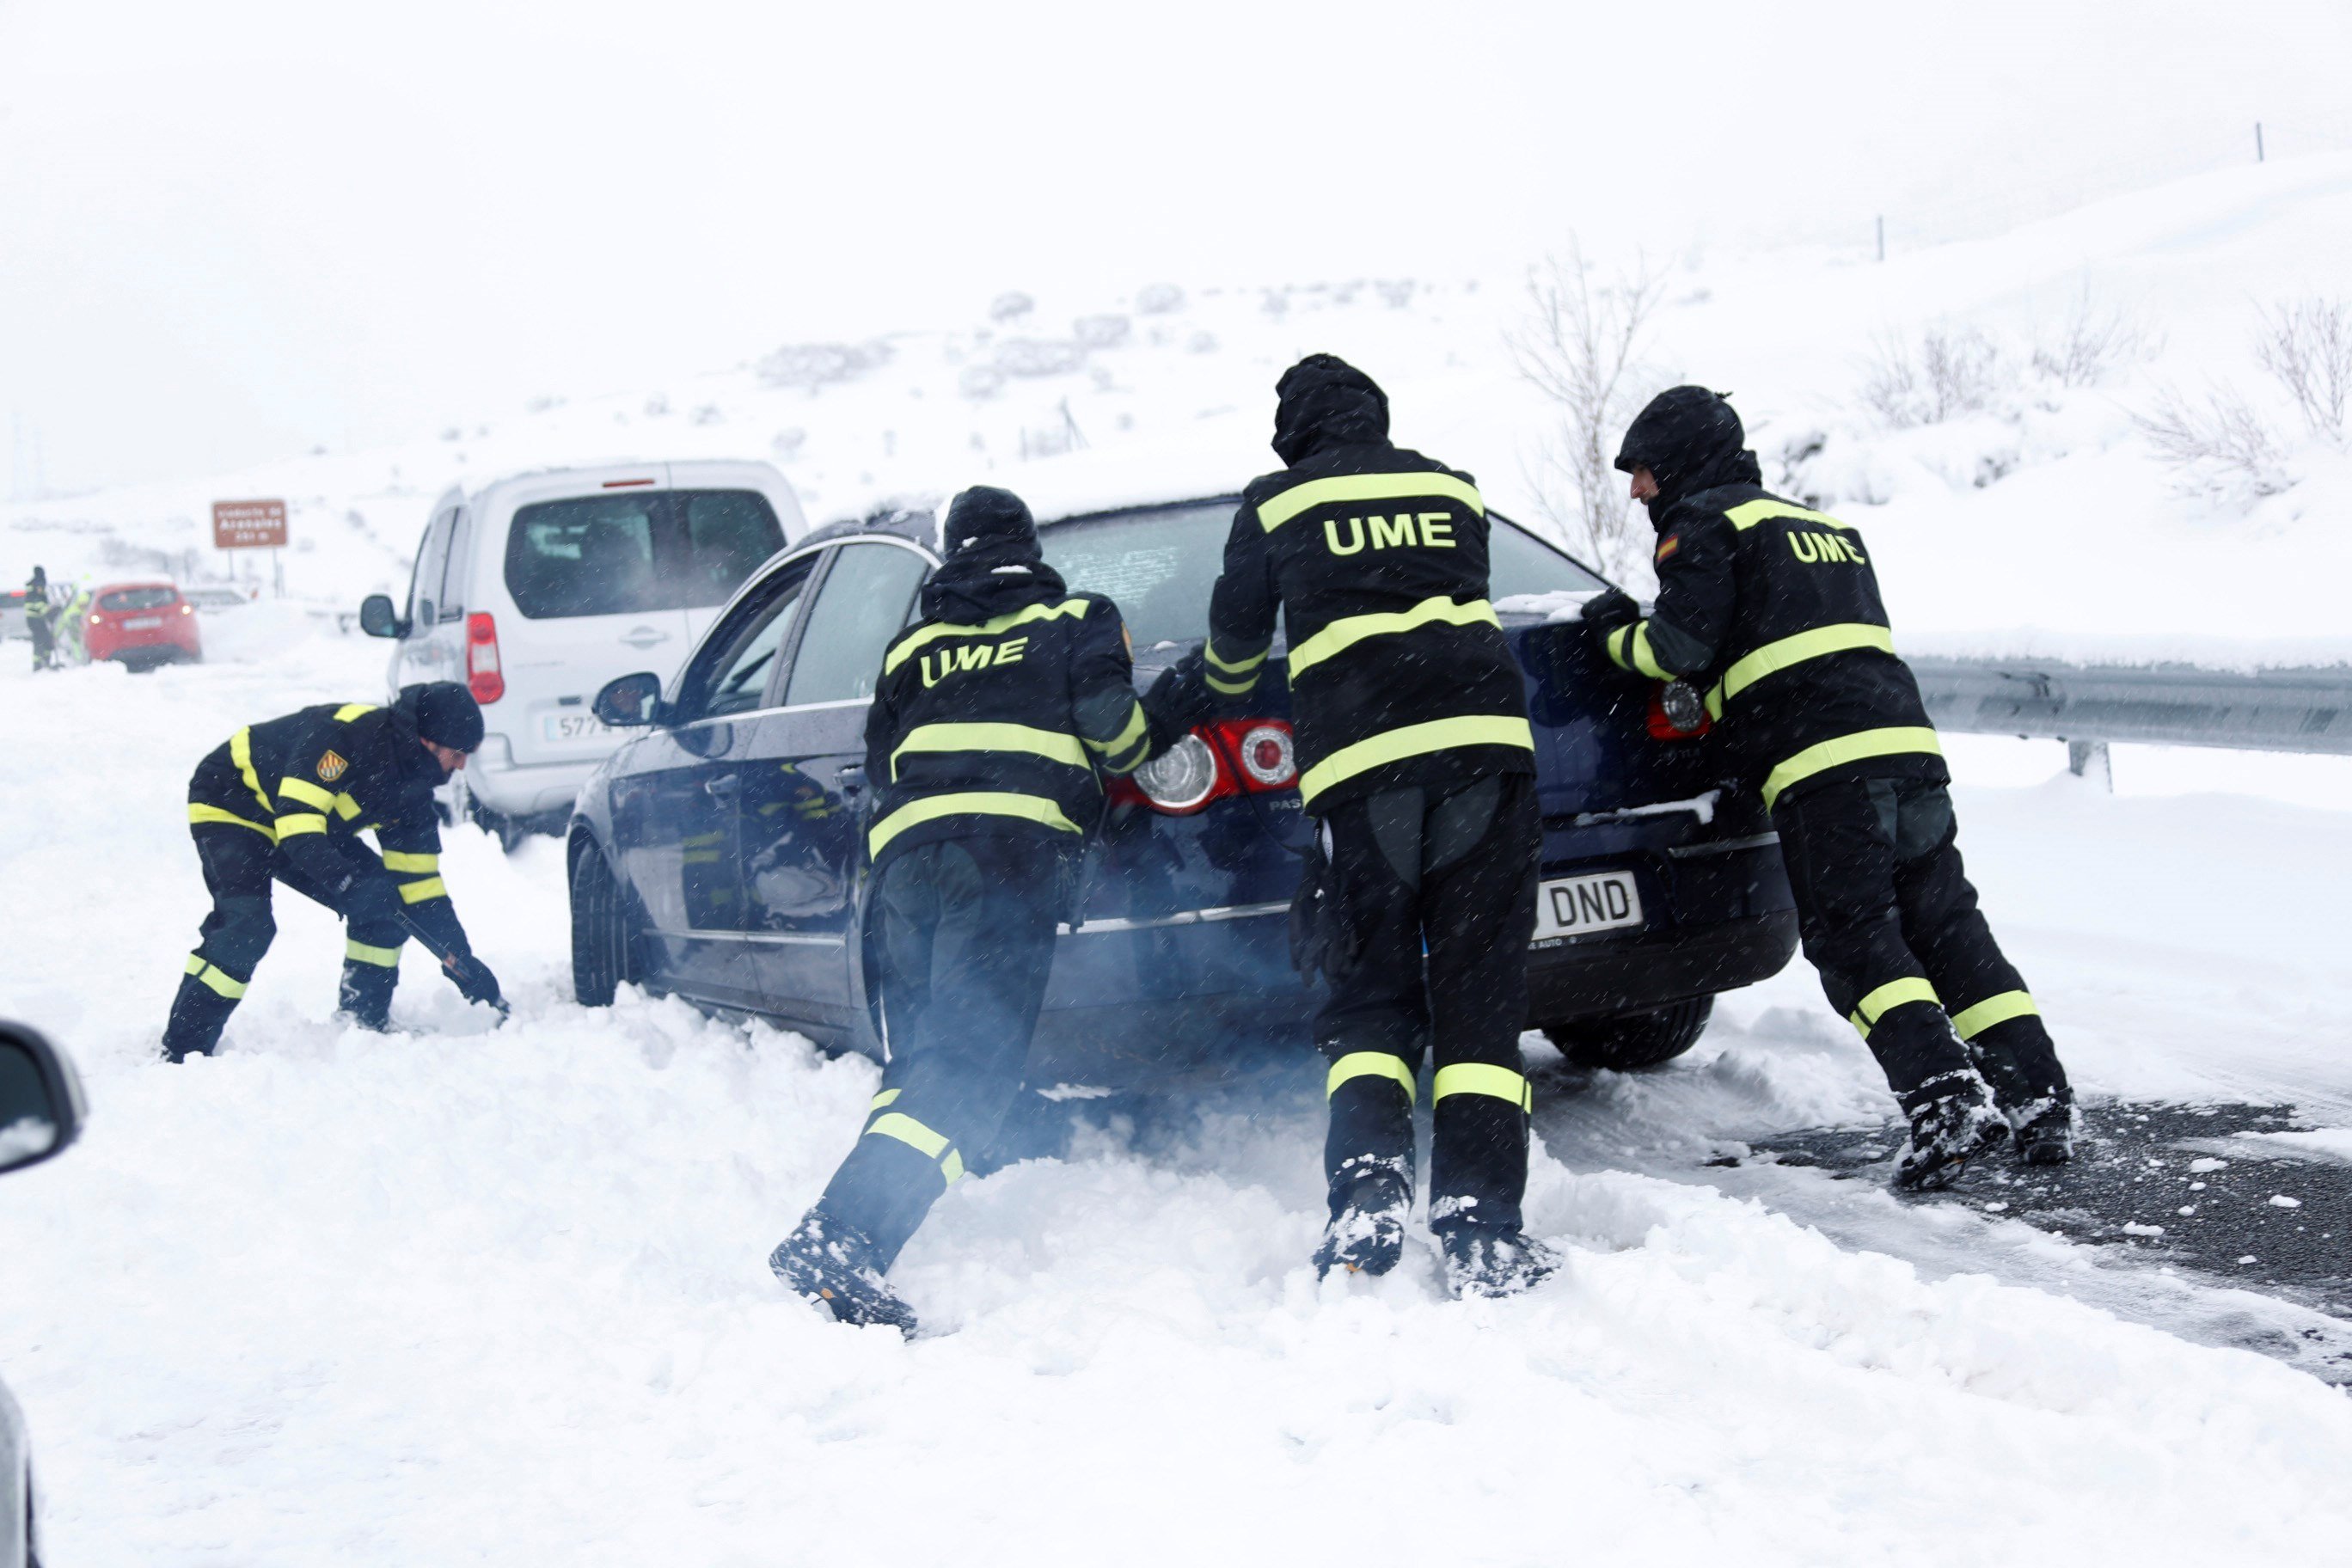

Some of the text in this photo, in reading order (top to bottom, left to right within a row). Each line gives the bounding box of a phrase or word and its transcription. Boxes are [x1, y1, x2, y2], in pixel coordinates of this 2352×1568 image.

[1324, 512, 1456, 555] UME
[1787, 531, 1865, 565] UME
[921, 636, 1029, 688] UME
[1550, 879, 1630, 928] DND
[1539, 938, 1562, 948] AUTO
